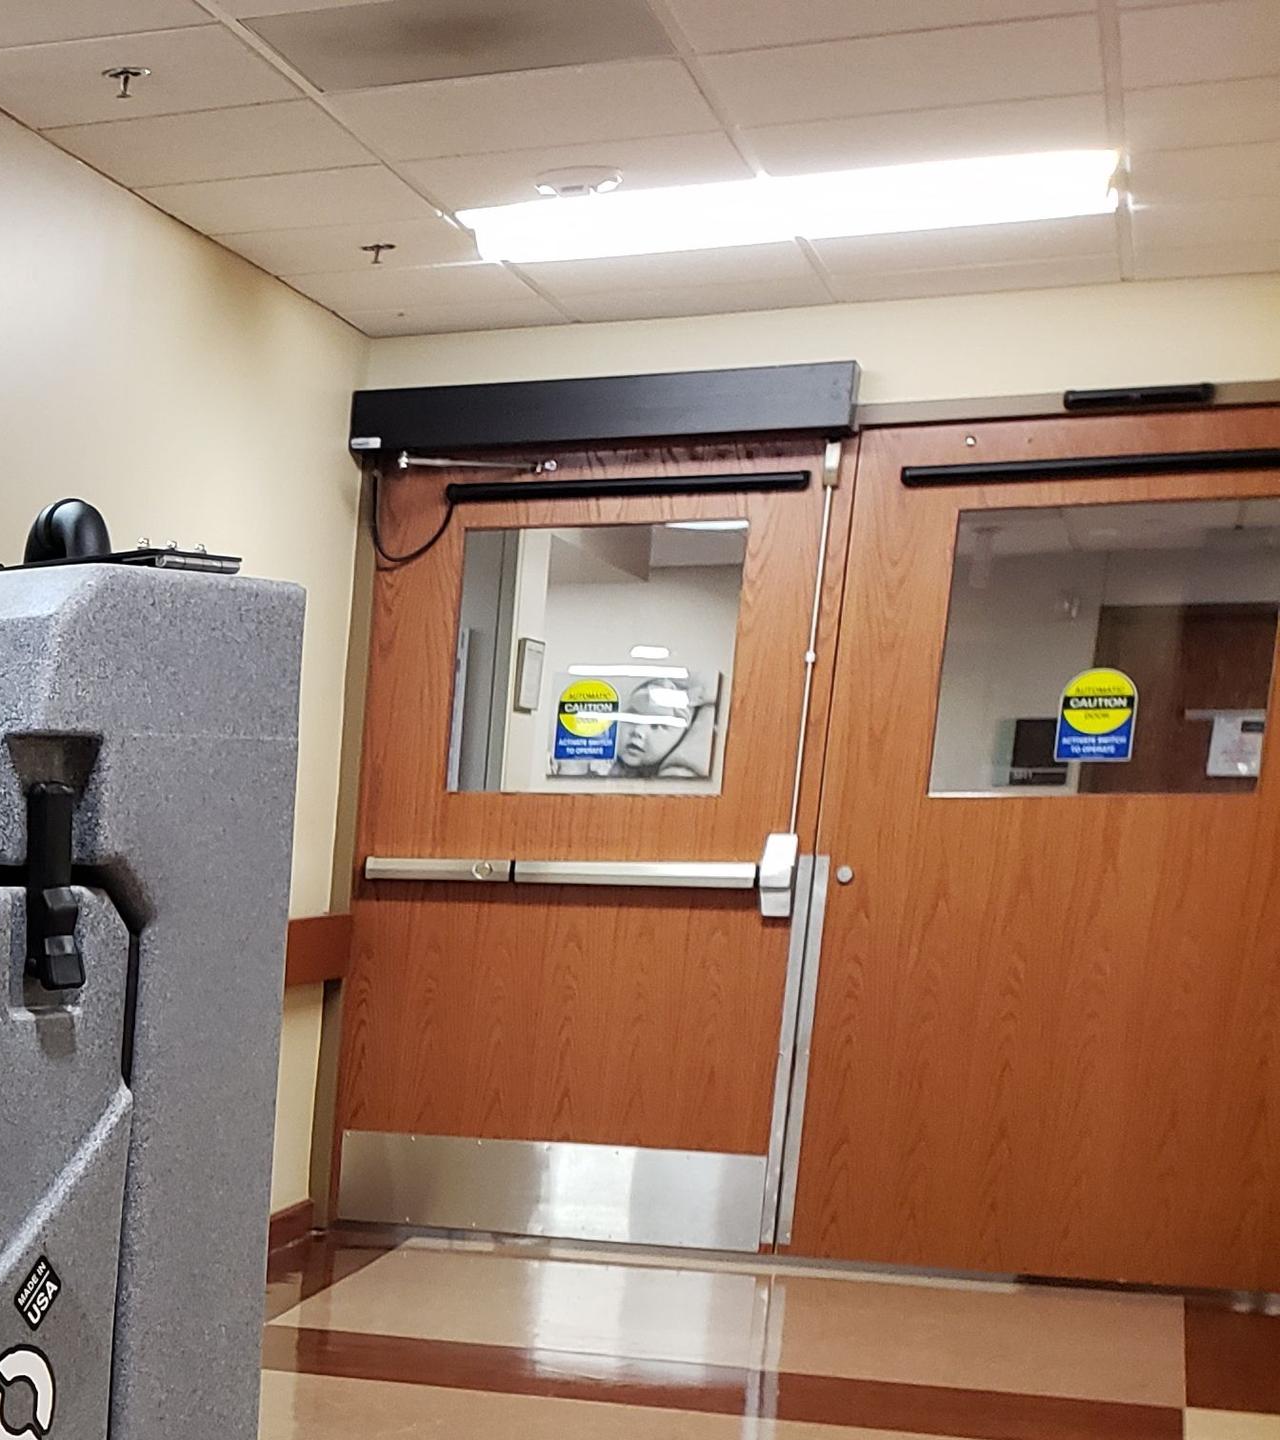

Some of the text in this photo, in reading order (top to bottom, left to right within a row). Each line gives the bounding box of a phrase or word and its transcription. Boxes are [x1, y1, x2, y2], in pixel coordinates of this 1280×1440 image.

[564, 703, 613, 712] CAUTION
[1070, 697, 1127, 708] CAUTION
[17, 1261, 47, 1306] MADE IN
[27, 1281, 58, 1324] USA
